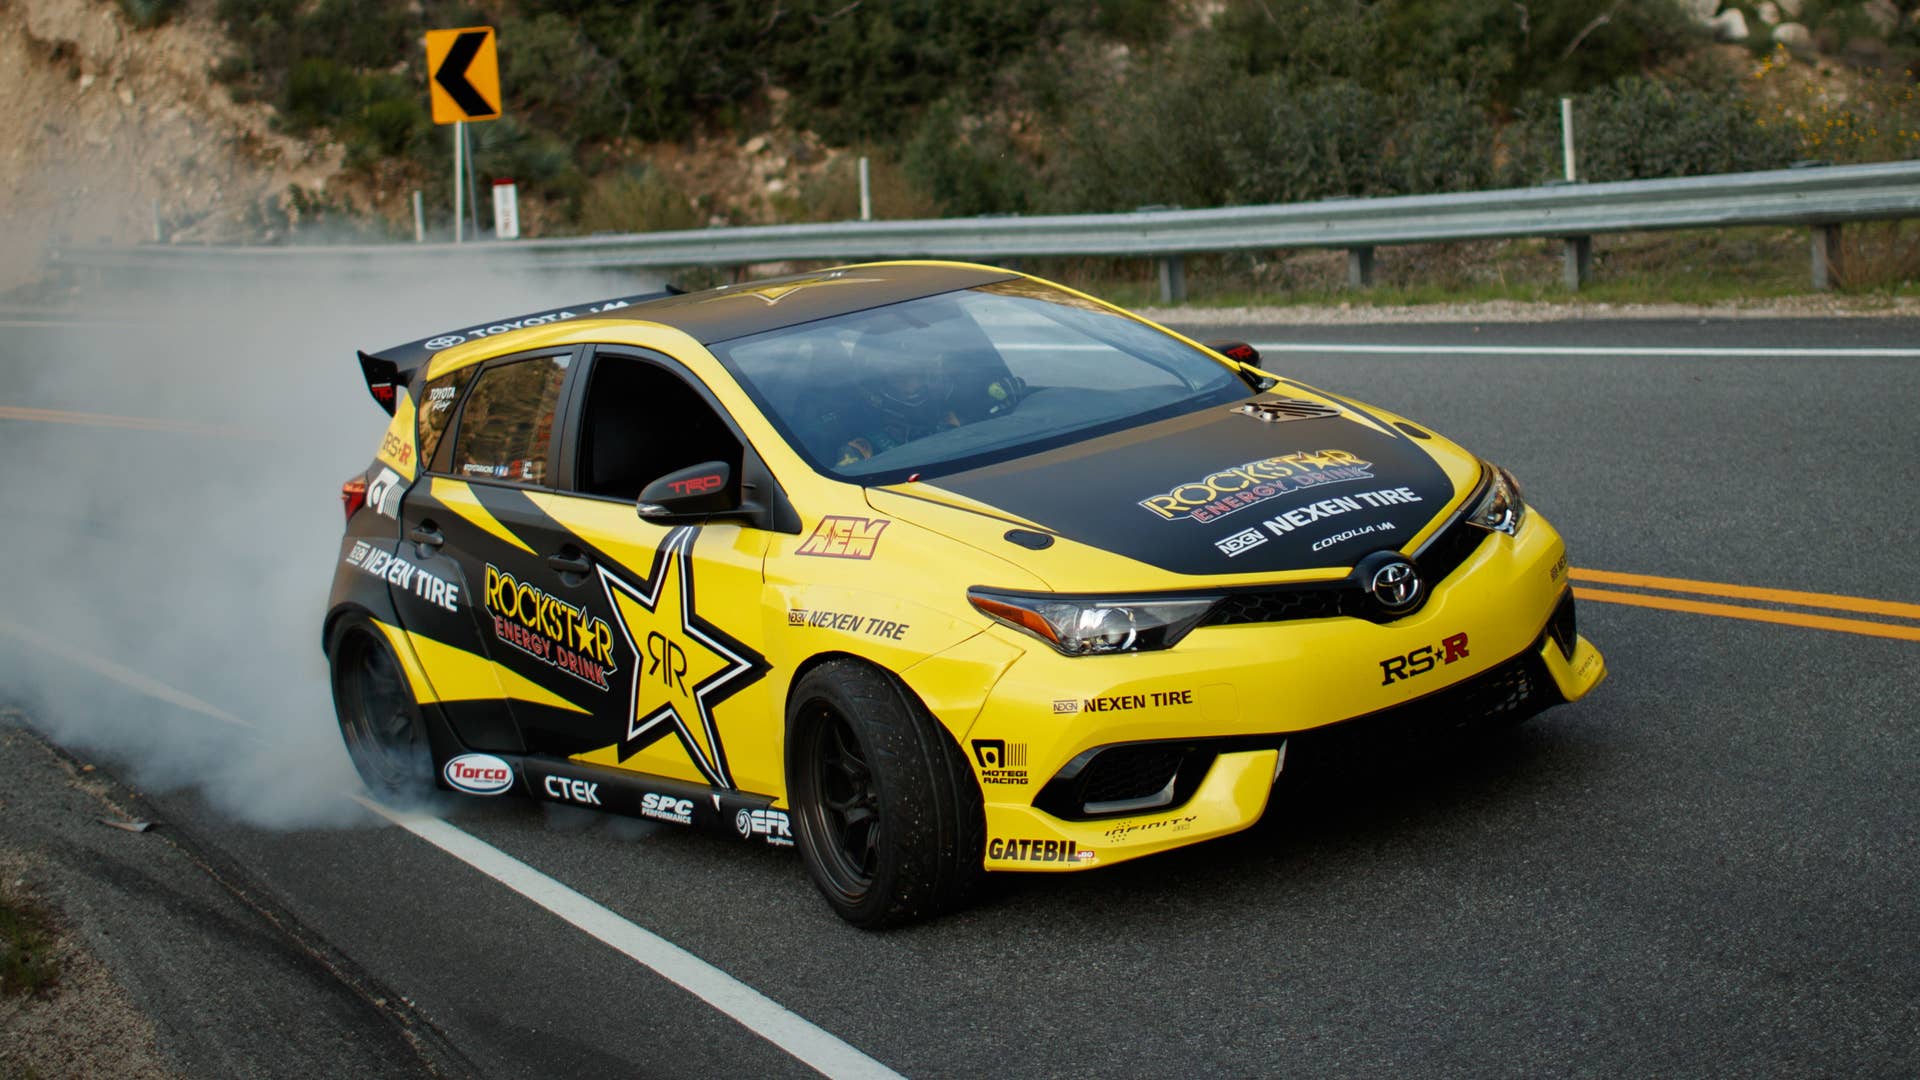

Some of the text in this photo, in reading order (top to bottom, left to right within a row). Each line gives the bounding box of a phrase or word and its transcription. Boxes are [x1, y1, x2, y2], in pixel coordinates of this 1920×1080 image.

[468, 311, 577, 339] TOYOTA
[429, 386, 456, 401] TOYOTA
[667, 475, 722, 494] TRD
[1191, 465, 1368, 522] ENERGY DRINK
[1262, 495, 1364, 537] NEXEN
[1354, 486, 1424, 508] TIRE
[1311, 525, 1375, 552] COROLLA
[361, 546, 416, 591] NEXEN
[415, 569, 460, 613] TIRE
[808, 610, 865, 632] NEXEN
[864, 617, 911, 640] TIRE
[495, 614, 607, 689] ENERGY DRINK
[1083, 694, 1146, 713] NEXEN
[1150, 689, 1193, 707] TIRE
[454, 762, 508, 780] Torco
[983, 777, 1029, 785] RACING
[544, 774, 601, 805] CTEK
[640, 792, 694, 816] SPC
[641, 807, 692, 824] PERFORMANCE
